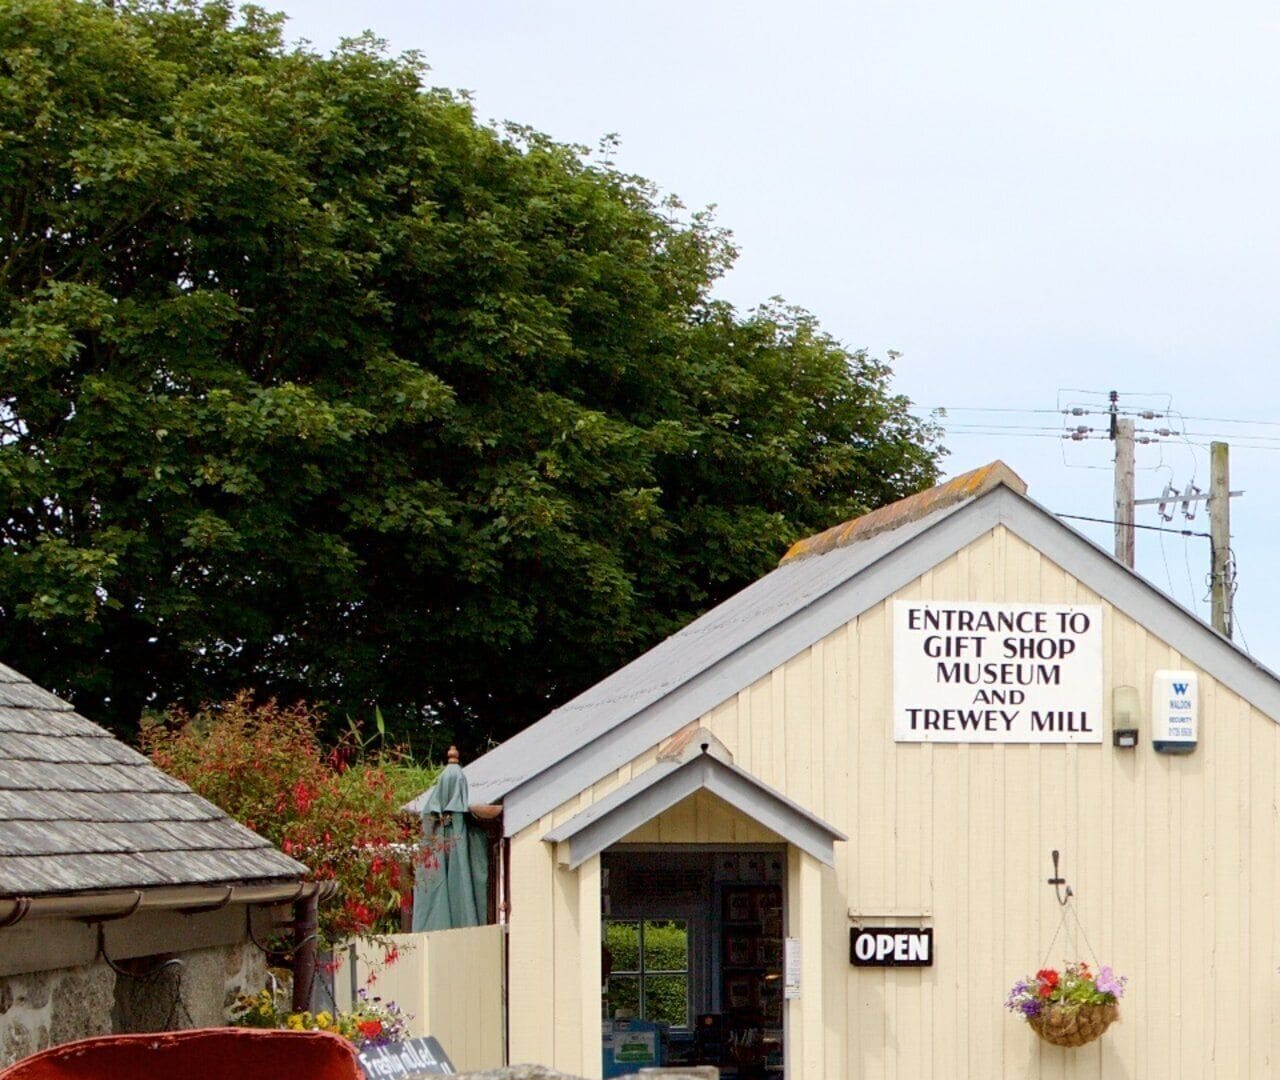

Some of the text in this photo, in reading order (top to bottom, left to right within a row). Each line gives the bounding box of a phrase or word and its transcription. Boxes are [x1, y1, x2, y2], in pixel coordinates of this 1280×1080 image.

[908, 609, 1090, 635] ENTRANCE TO
[923, 636, 1075, 660] GIFT SHOP
[936, 662, 1061, 685] MUSEUM
[972, 690, 1025, 705] AND
[1172, 683, 1189, 695] W
[905, 708, 1093, 732] TREWEY MILL
[855, 933, 929, 961] OPEN
